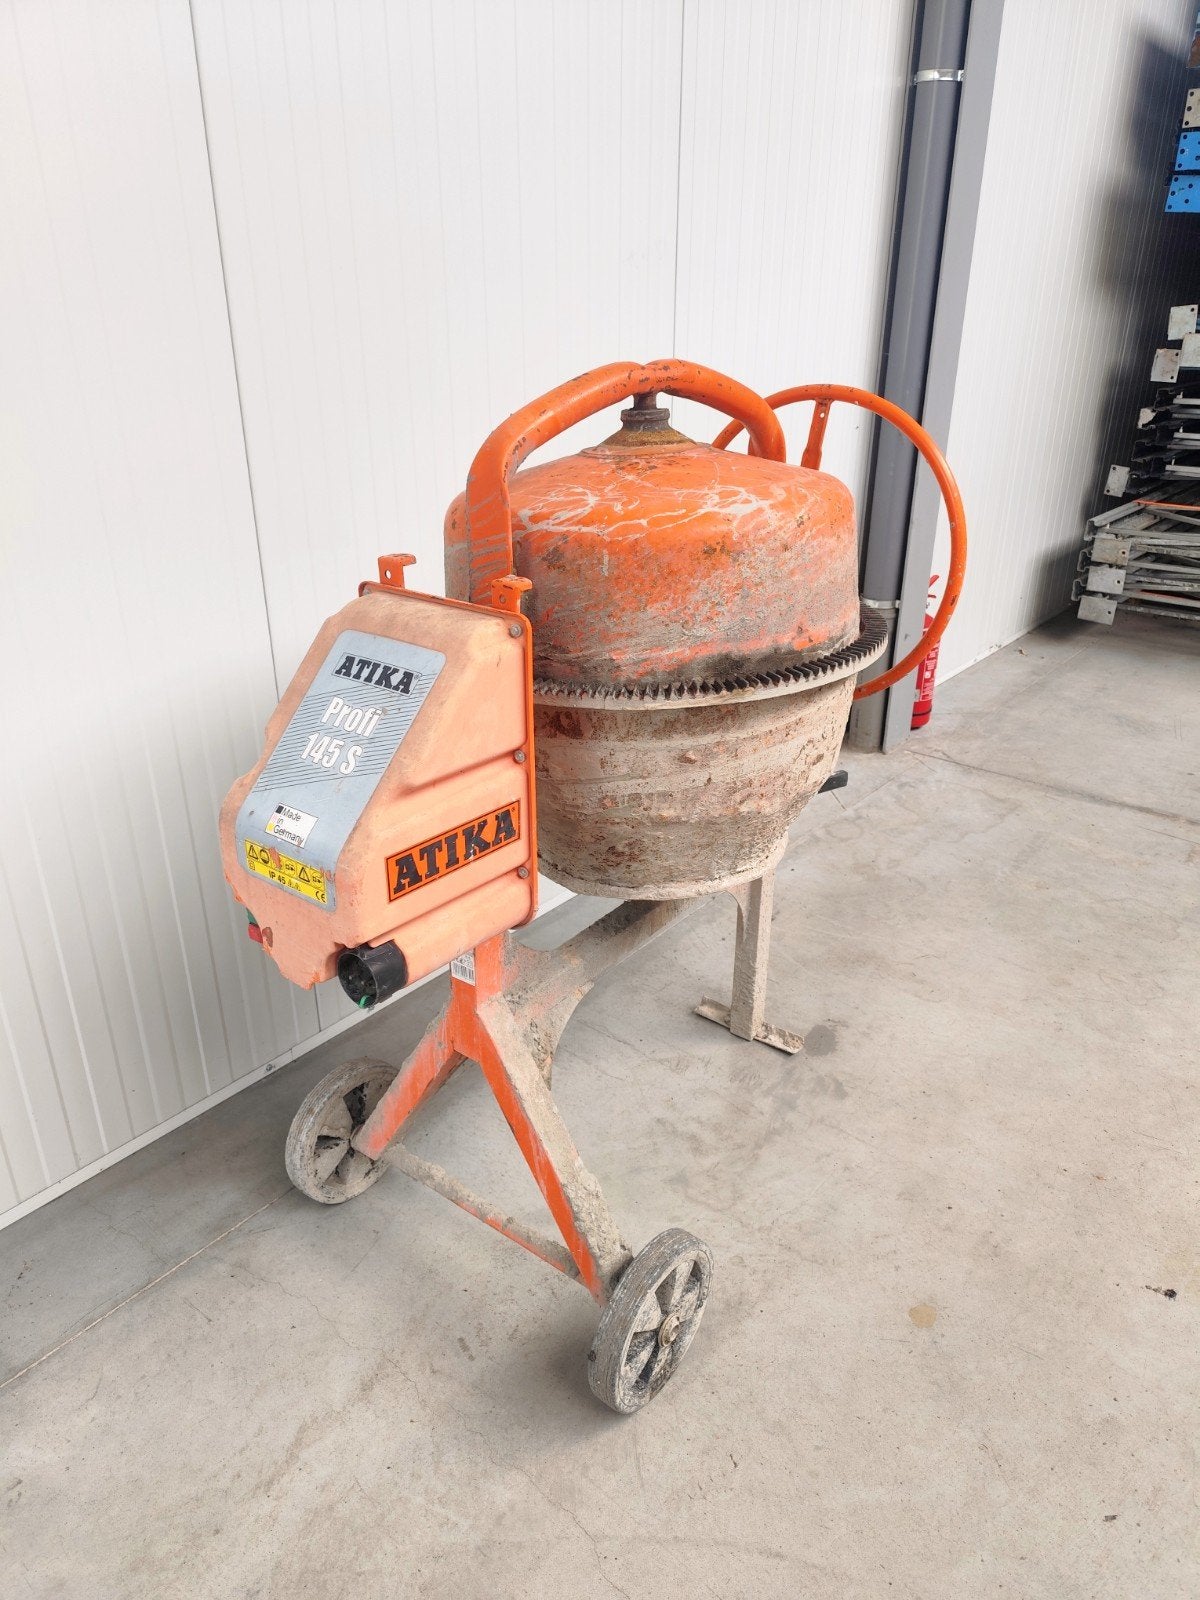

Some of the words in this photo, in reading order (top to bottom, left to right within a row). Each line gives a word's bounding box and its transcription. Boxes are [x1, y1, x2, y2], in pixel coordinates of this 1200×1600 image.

[335, 655, 414, 695] ATIKA
[320, 696, 382, 738] Profi
[301, 732, 345, 768] 145
[339, 745, 363, 775] S
[273, 824, 305, 845] Germany
[277, 817, 284, 825] in
[281, 807, 302, 822] Made
[393, 809, 517, 895] ATIKA
